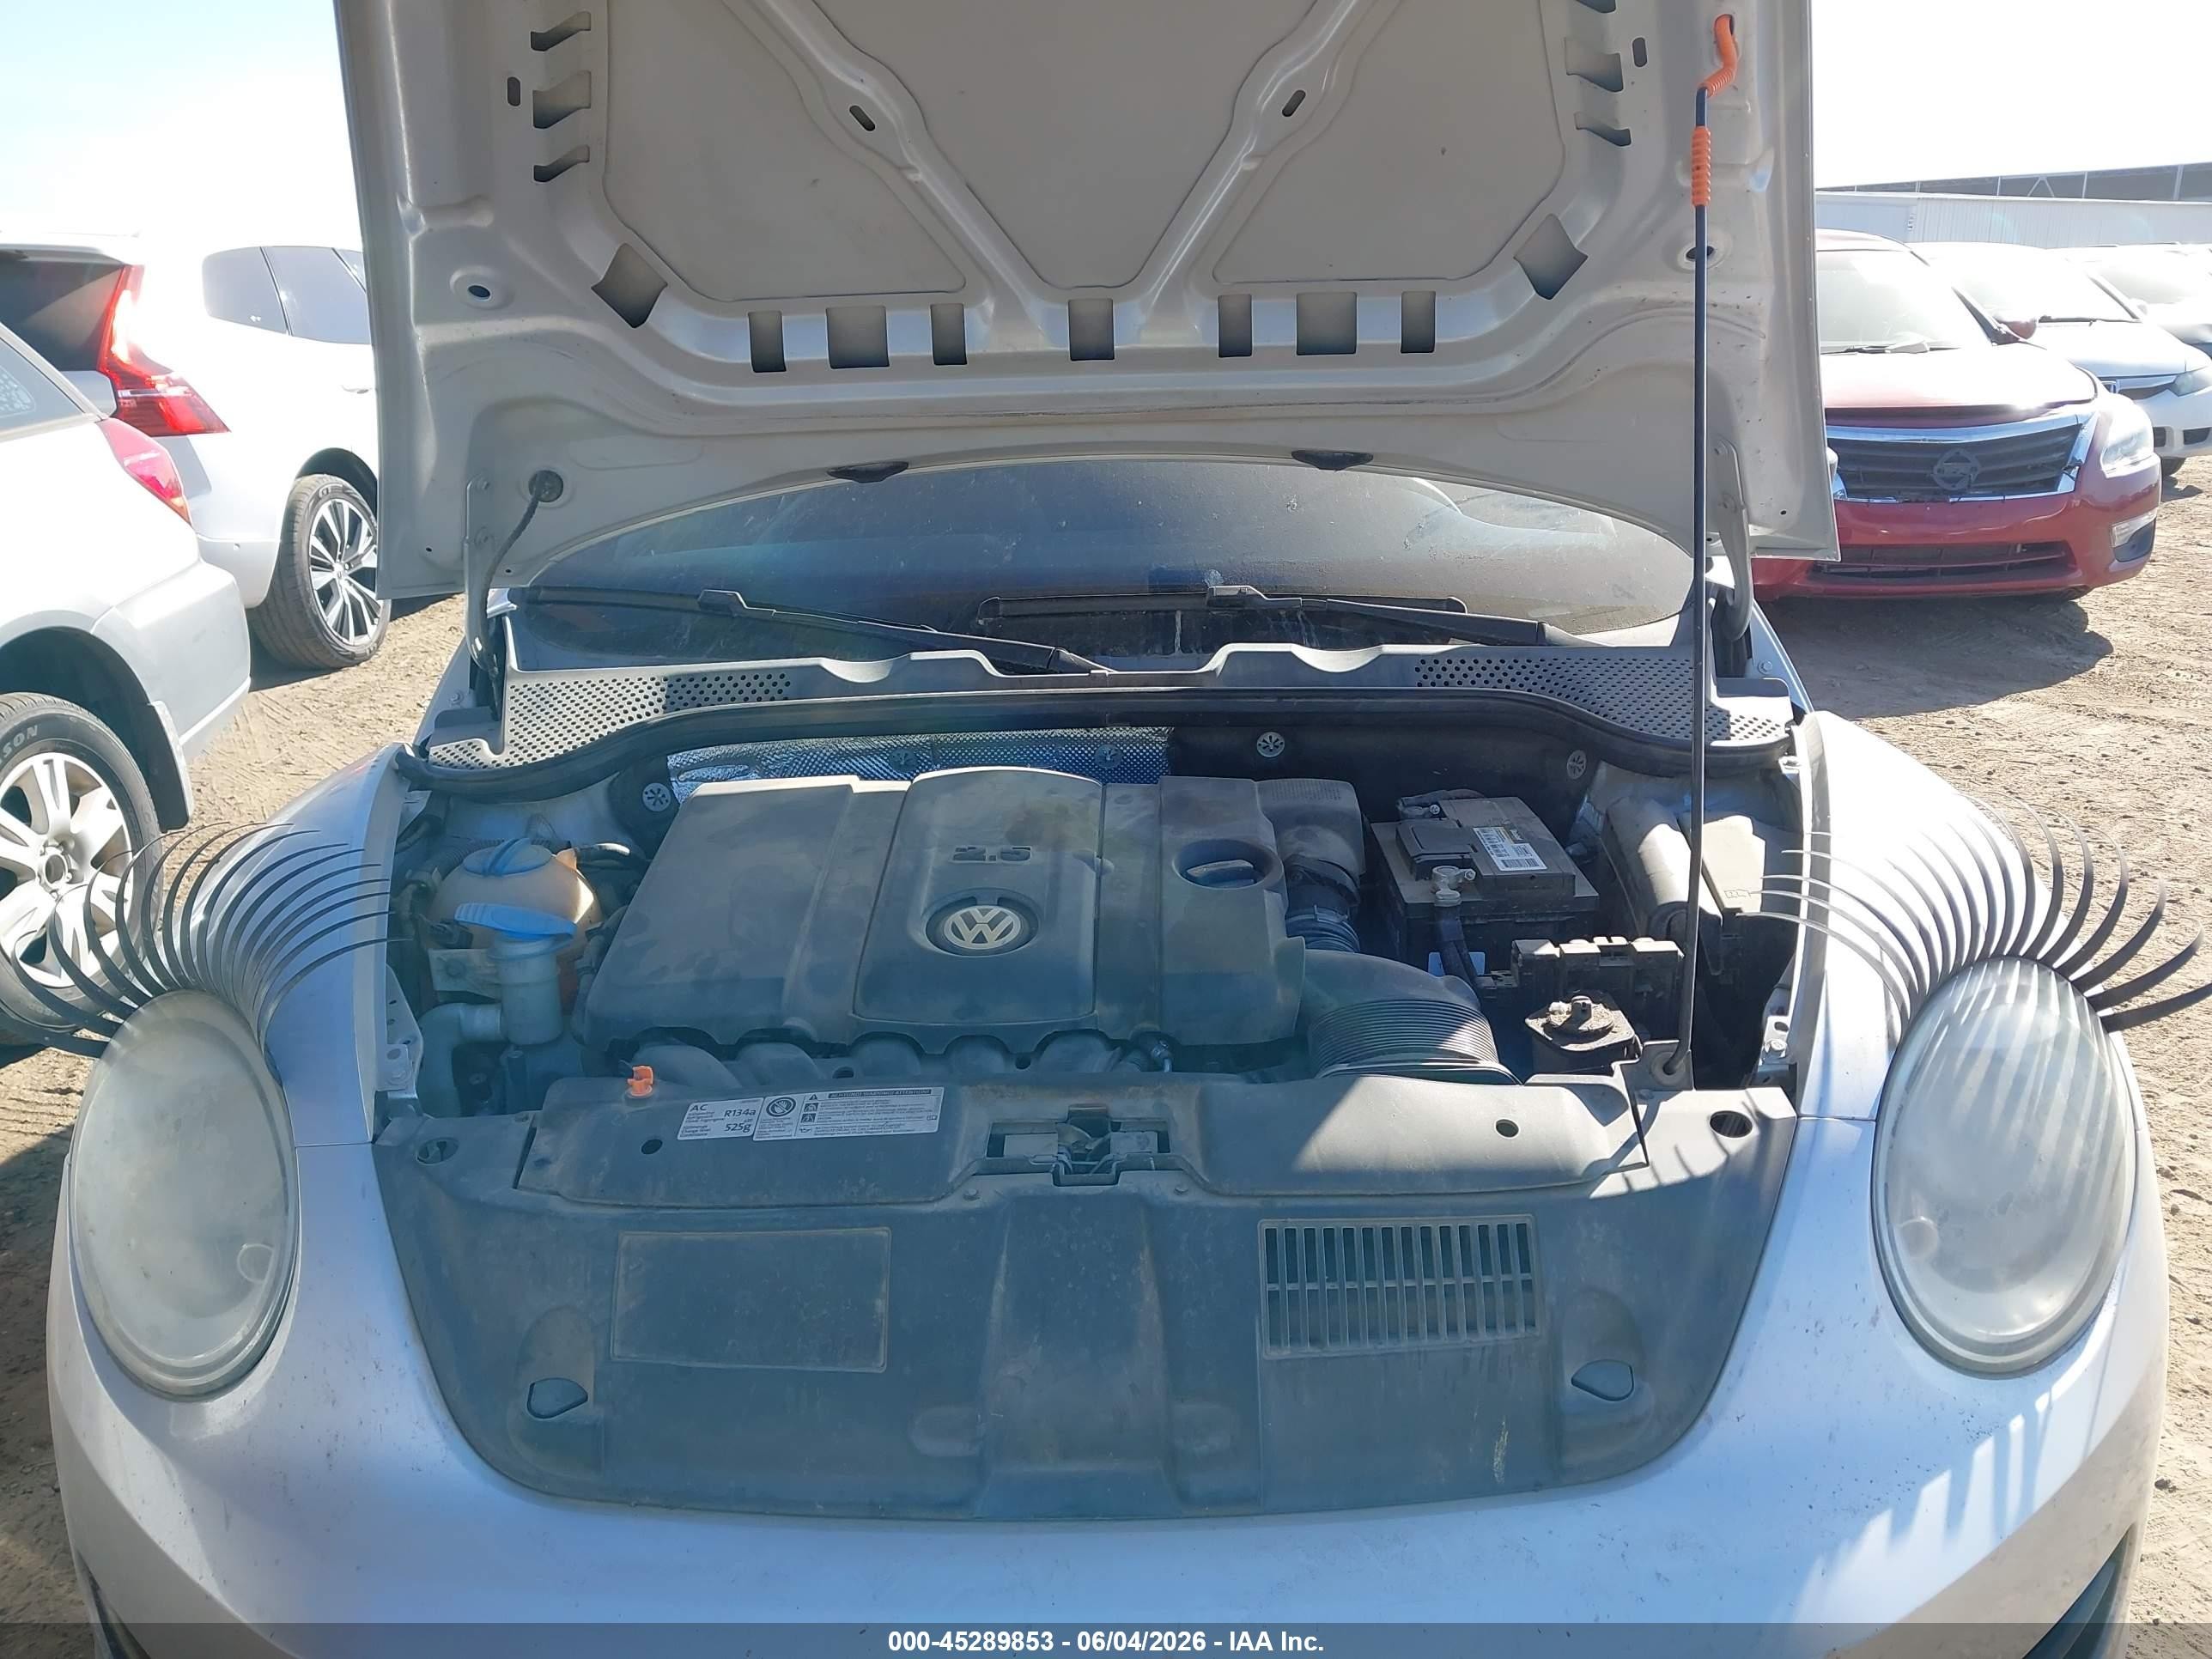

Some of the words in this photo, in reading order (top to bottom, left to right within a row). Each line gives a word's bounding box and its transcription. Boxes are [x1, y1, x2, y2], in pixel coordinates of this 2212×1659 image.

[0, 725, 38, 764] SON
[952, 846, 1031, 863] 2.5
[724, 1109, 756, 1117] R134a
[724, 1122, 751, 1133] 525g
